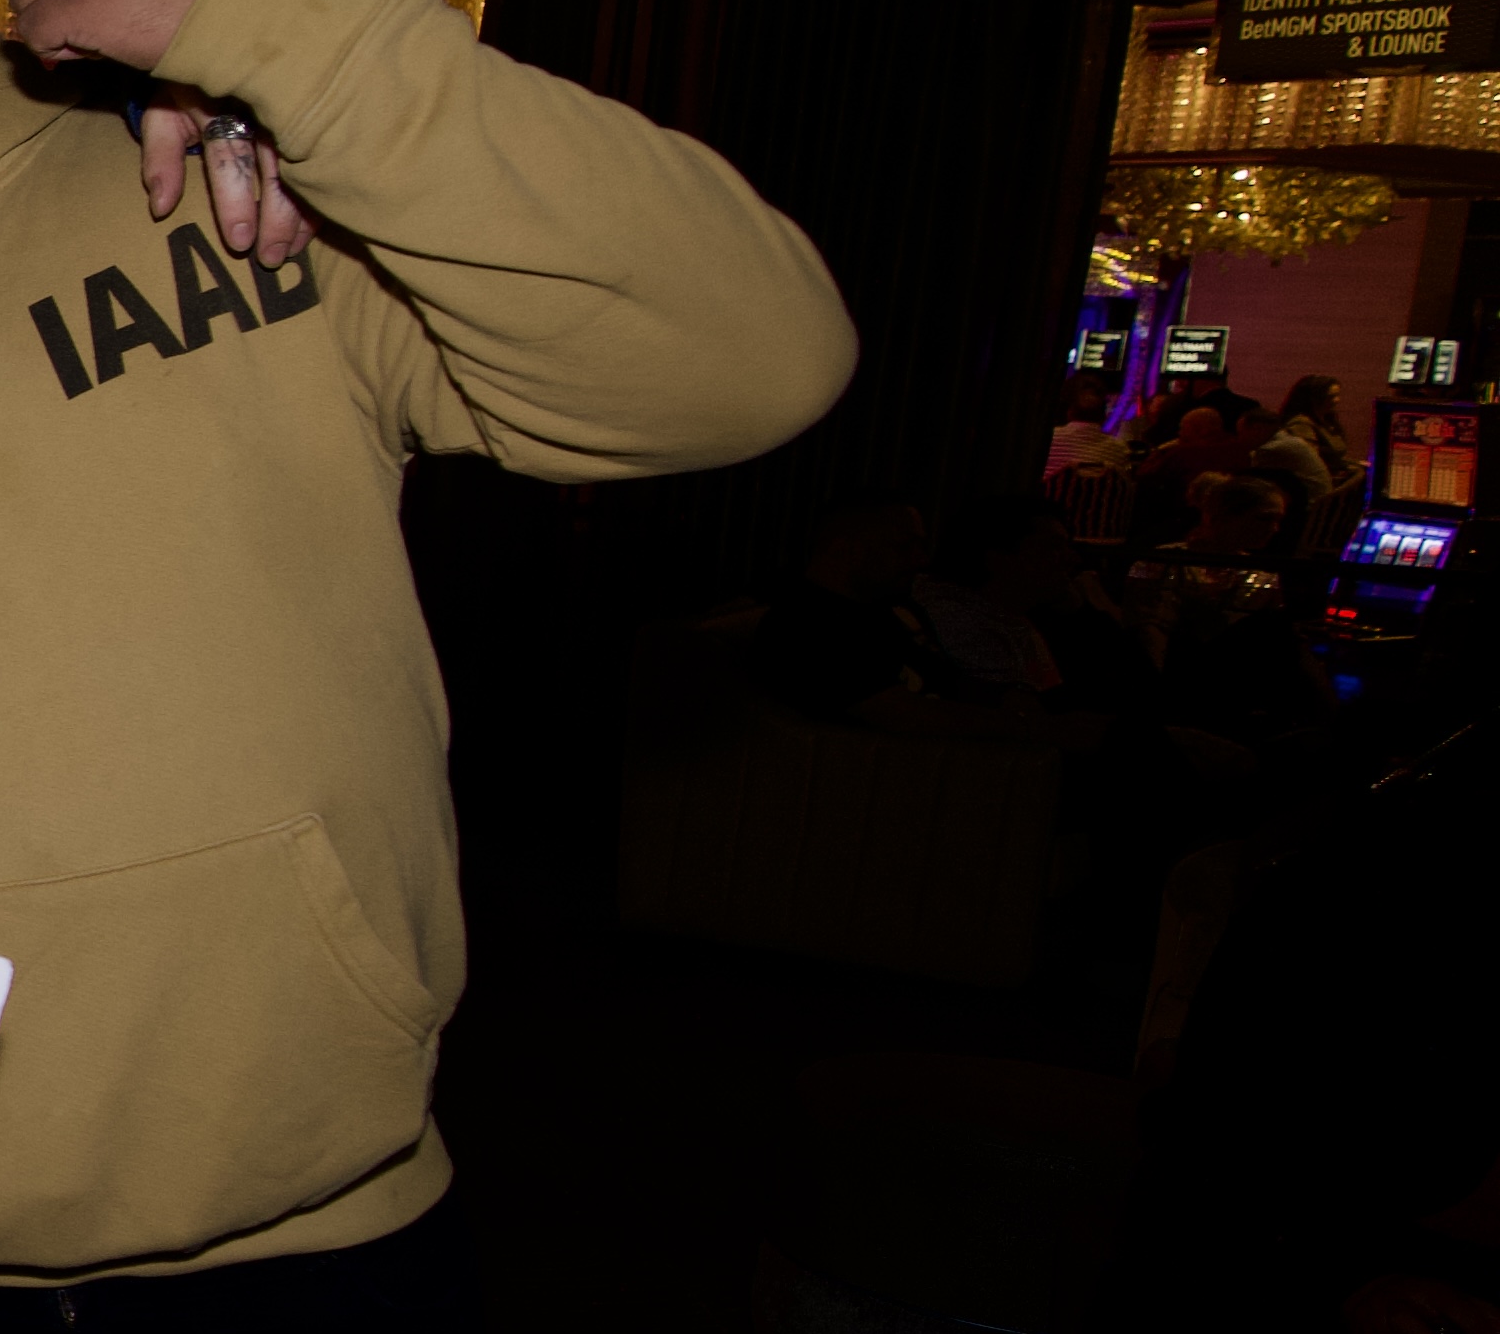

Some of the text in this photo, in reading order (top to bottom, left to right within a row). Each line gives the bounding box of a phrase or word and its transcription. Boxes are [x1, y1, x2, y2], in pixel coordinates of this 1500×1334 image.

[1240, 5, 1452, 40] BetMGM SPORTSBOOK
[1347, 31, 1448, 57] & LOUNGE
[28, 222, 321, 400] IAAB
